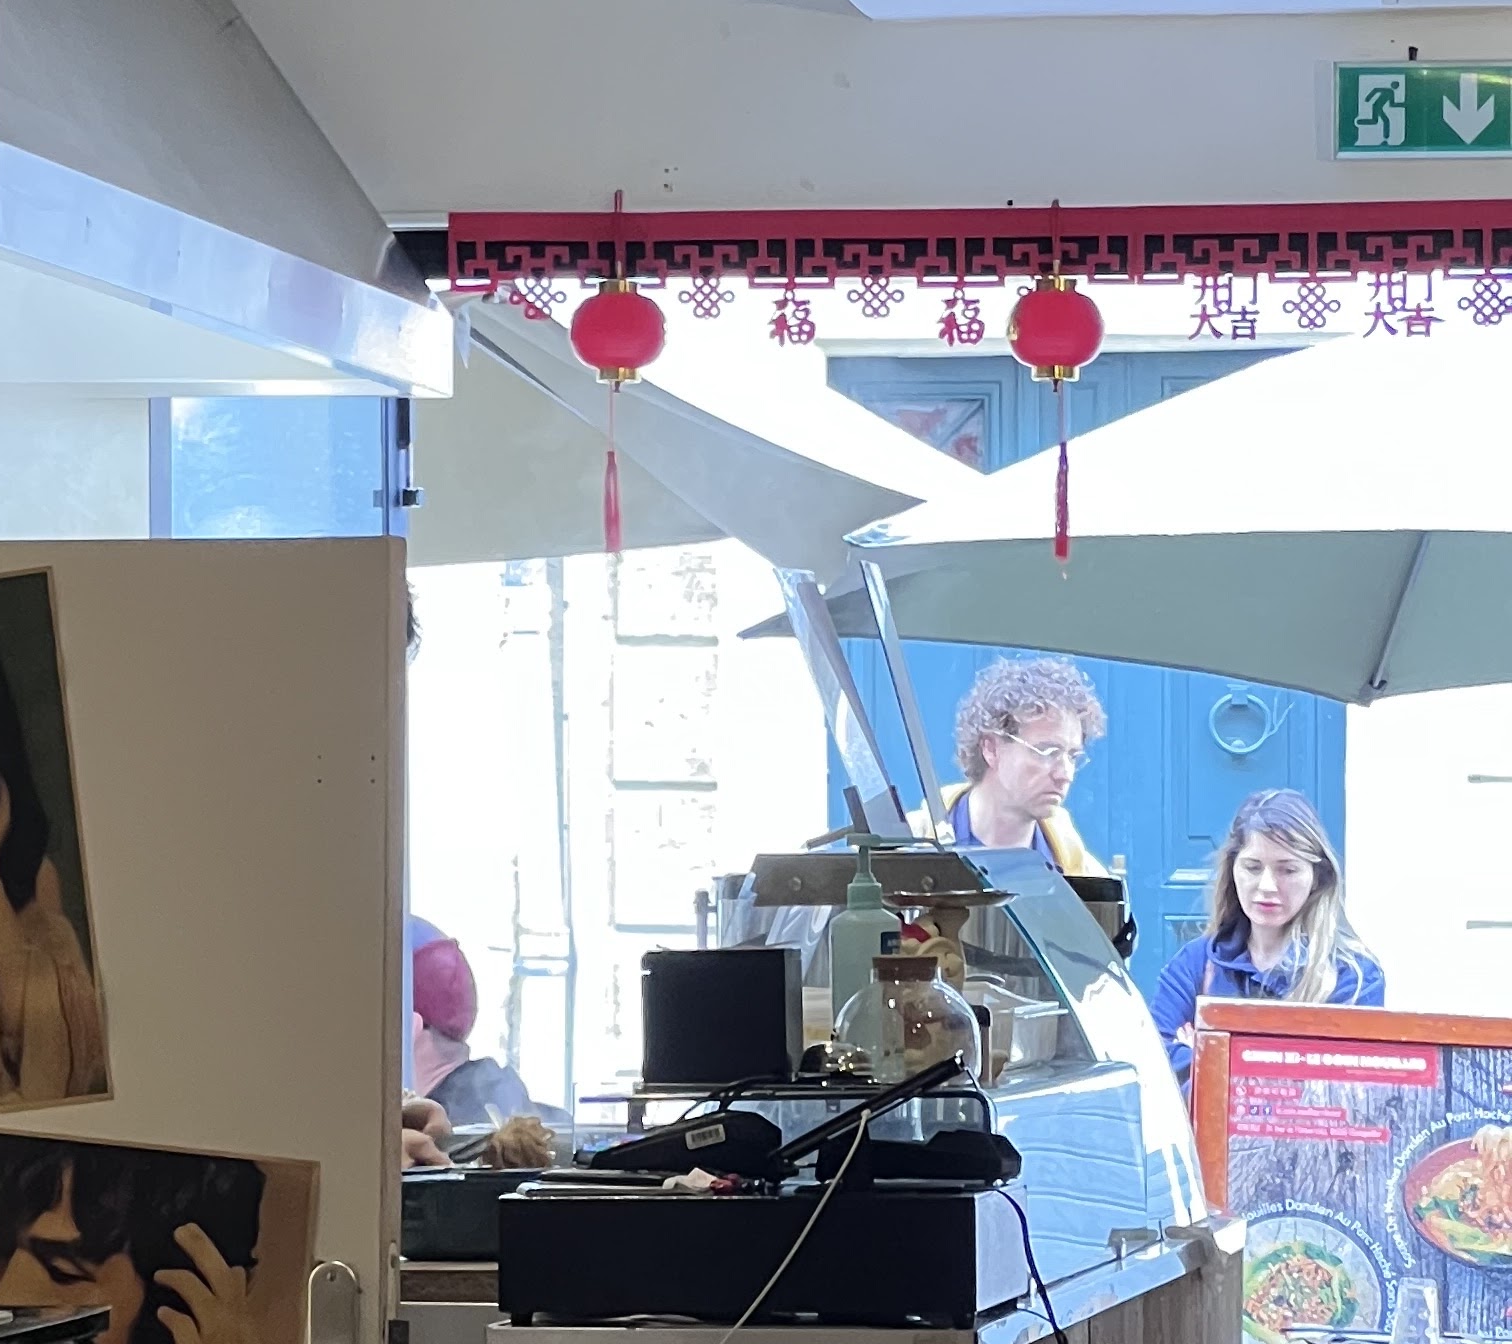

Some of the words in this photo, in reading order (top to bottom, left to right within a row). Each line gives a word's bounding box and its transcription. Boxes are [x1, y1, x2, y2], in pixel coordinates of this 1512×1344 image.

[767, 298, 816, 347] 福
[937, 298, 985, 347] 福
[1430, 1117, 1447, 1133] Au
[1240, 1201, 1284, 1223] ouilles
[1285, 1198, 1335, 1219] Dandan
[1334, 1211, 1352, 1227] Au
